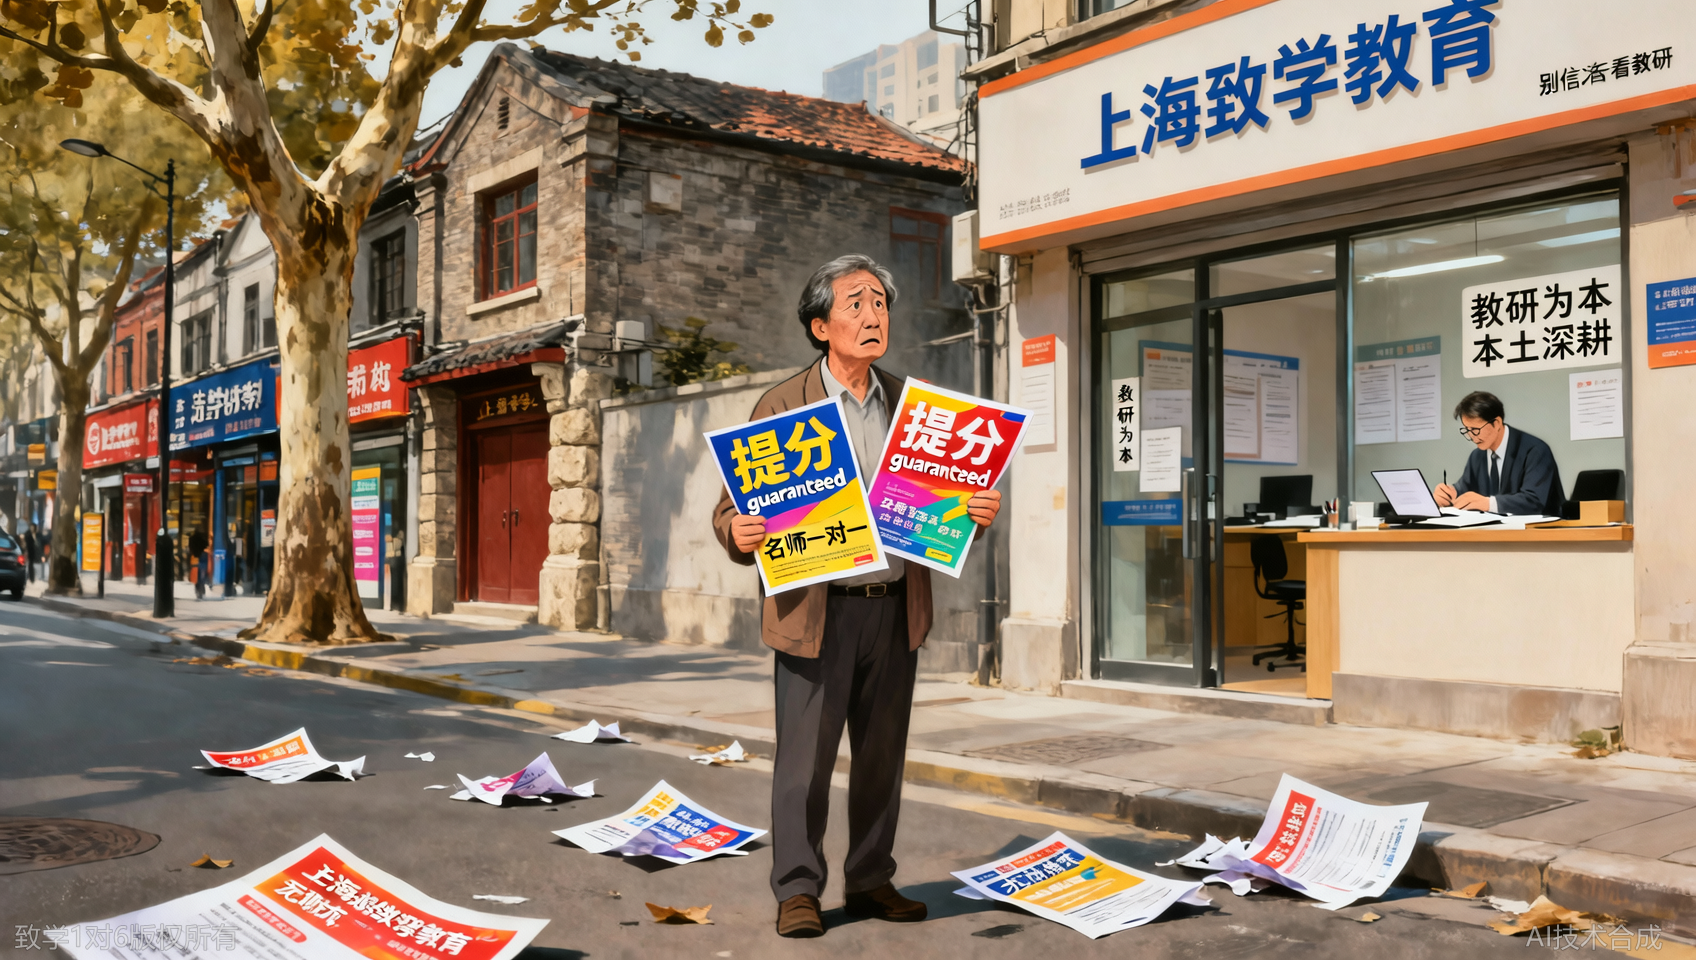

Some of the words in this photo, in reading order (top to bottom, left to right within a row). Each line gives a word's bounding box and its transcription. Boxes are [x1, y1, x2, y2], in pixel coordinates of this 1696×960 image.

[1080, 0, 1499, 171] 上海致学教育
[1470, 277, 1613, 330] 教研为本
[1472, 318, 1613, 368] 本土深耕
[899, 400, 1005, 466] 提分
[1116, 384, 1135, 464] 教研为本
[730, 415, 838, 495] 提分
[747, 467, 847, 516] guaranteed
[764, 520, 868, 561] 名师一对一
